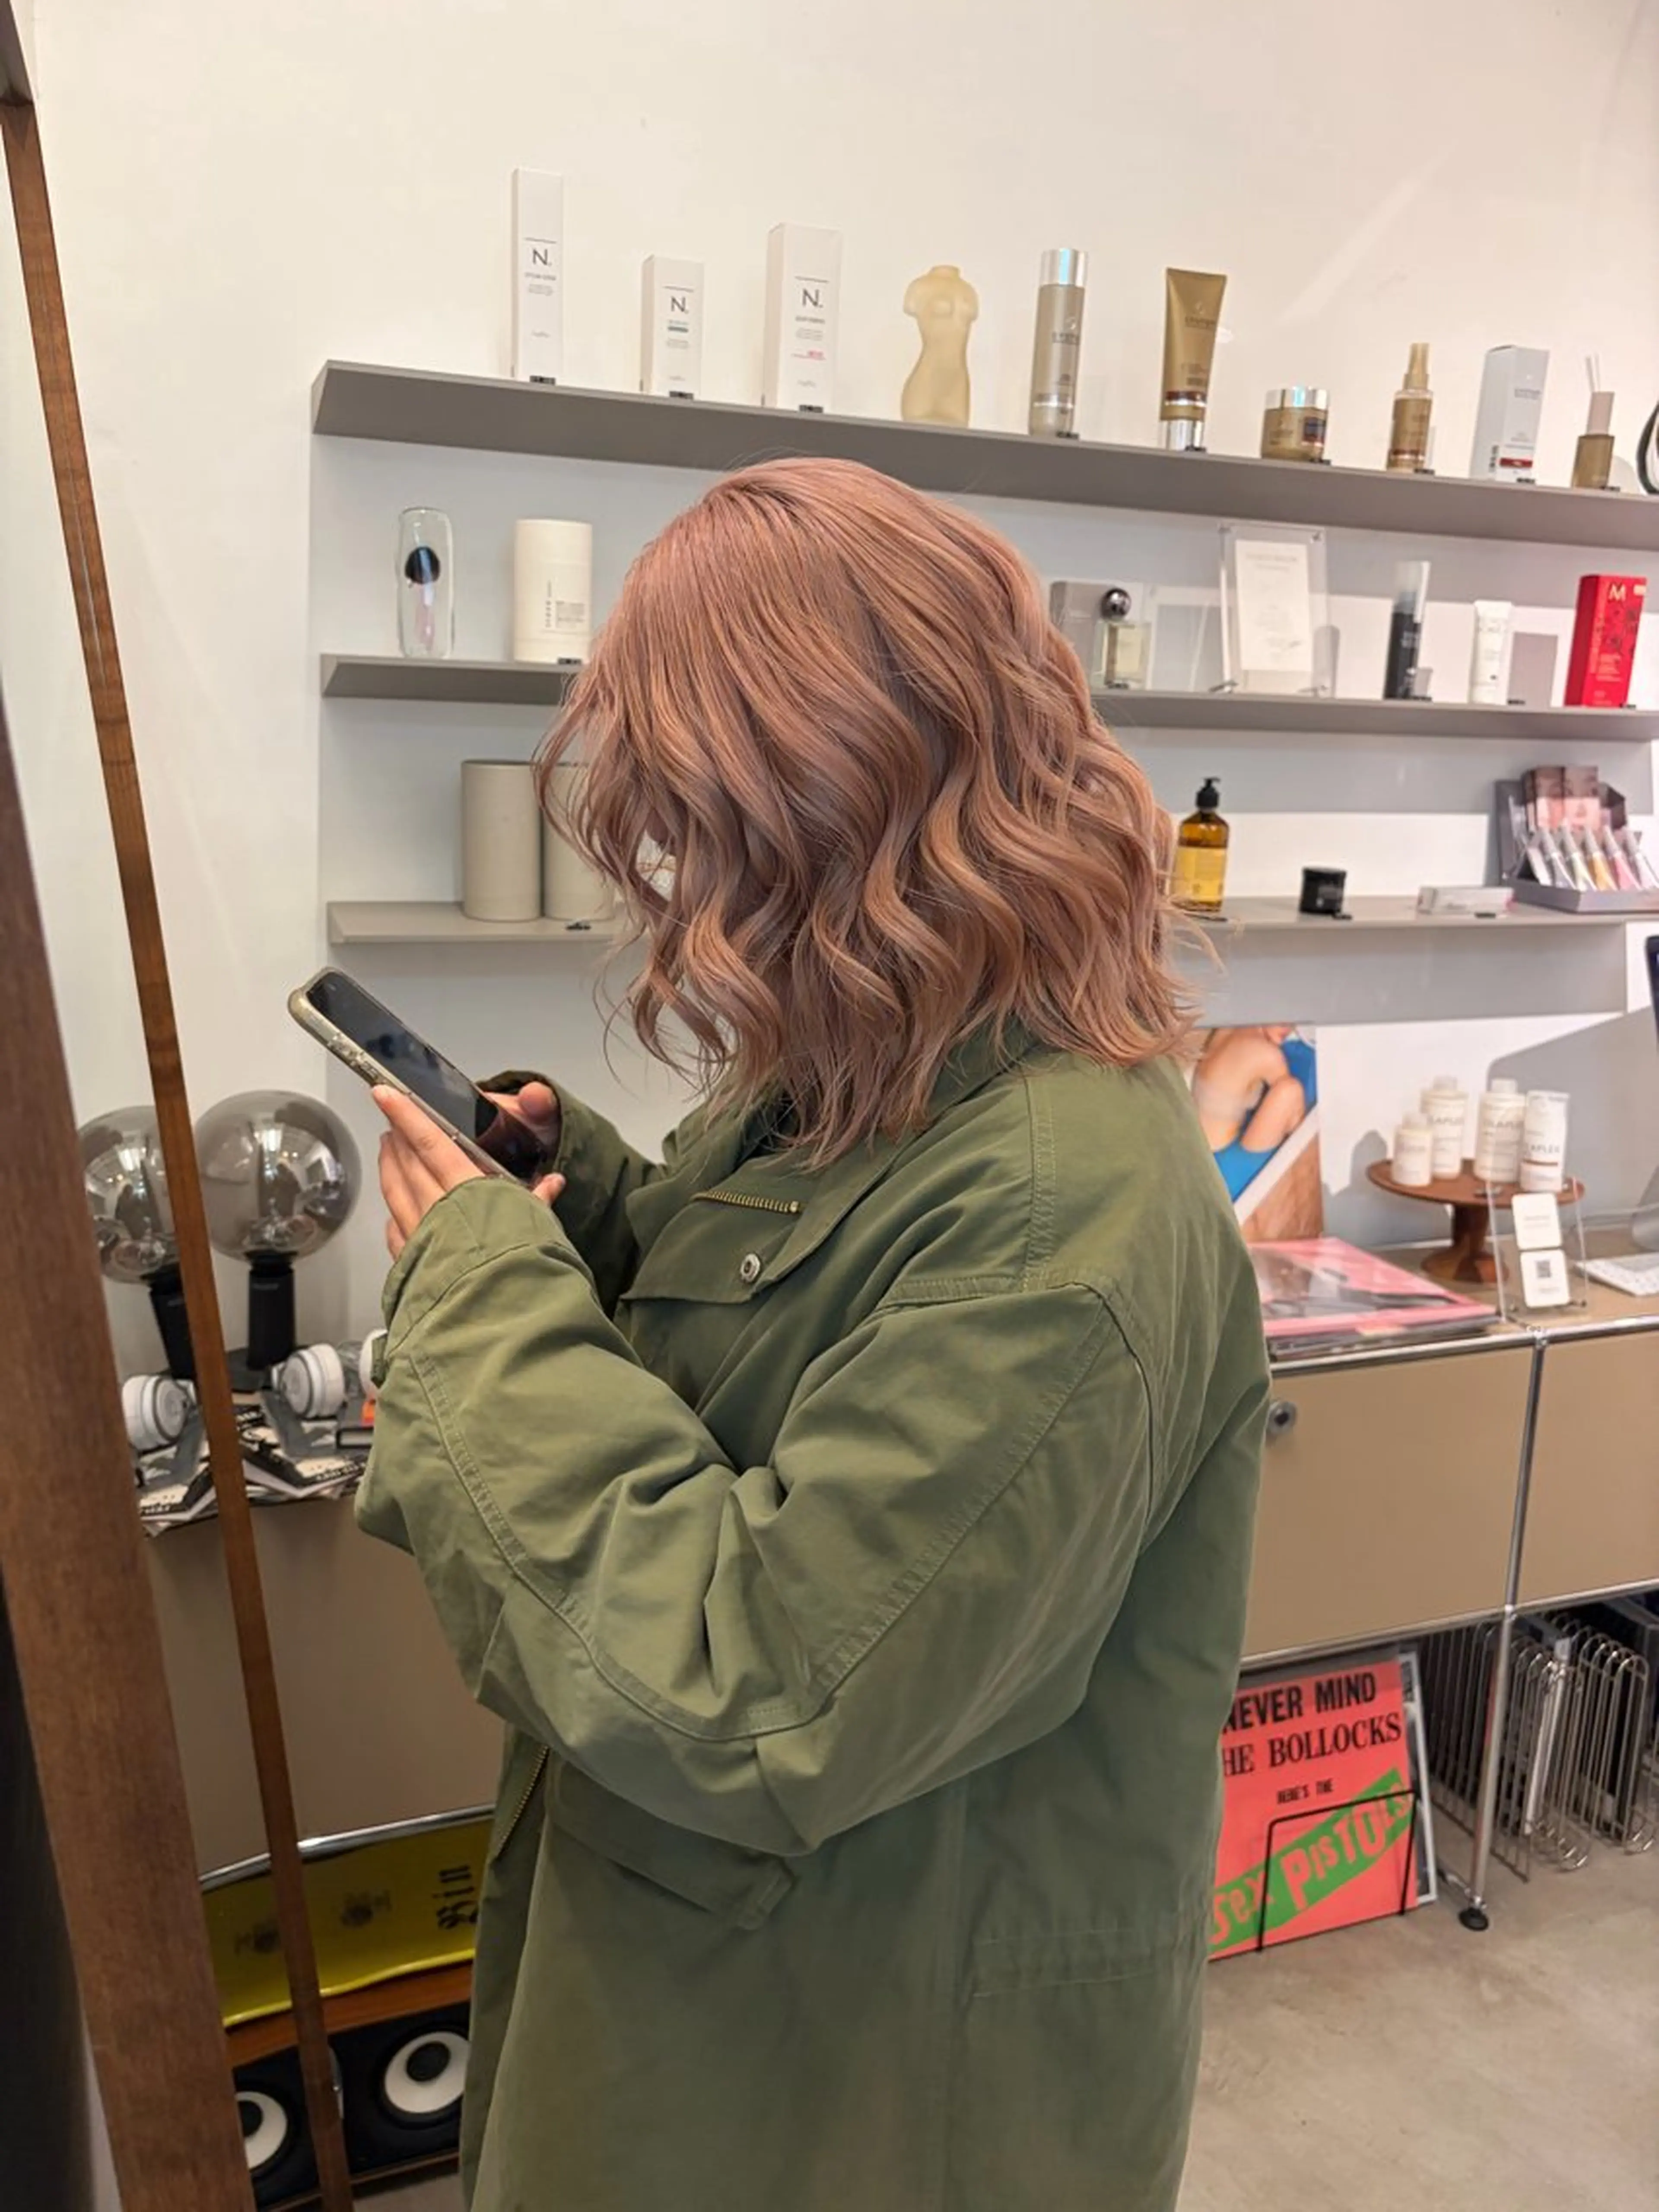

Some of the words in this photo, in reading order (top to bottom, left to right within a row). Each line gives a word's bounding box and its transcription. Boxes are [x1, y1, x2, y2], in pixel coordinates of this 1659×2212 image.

[1223, 1685, 1303, 1734] NEVER
[1315, 1672, 1376, 1714] MIND
[1221, 1744, 1255, 1777] HE
[1268, 1712, 1402, 1768] BOLLOCKS
[1316, 1778, 1334, 1794] THE
